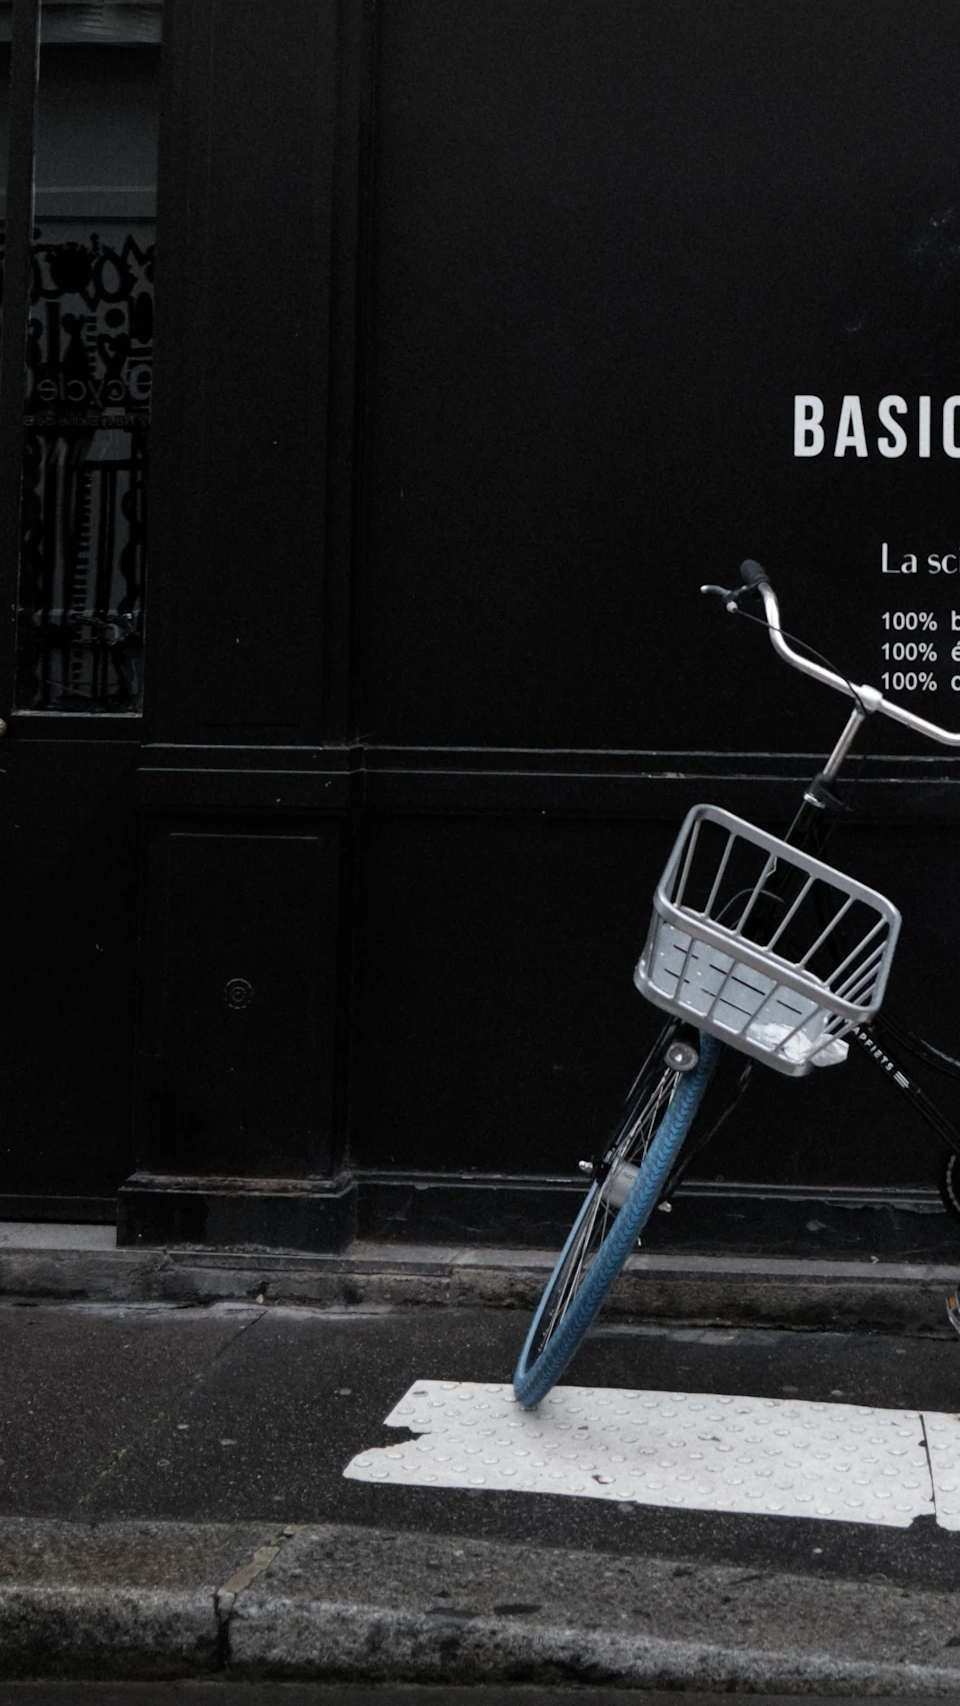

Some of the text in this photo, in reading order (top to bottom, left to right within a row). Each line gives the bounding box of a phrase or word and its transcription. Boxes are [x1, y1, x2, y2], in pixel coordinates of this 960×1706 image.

[881, 542, 918, 574] La
[881, 611, 938, 632] 100%
[881, 642, 938, 662] 100%
[881, 671, 938, 691] 100%
